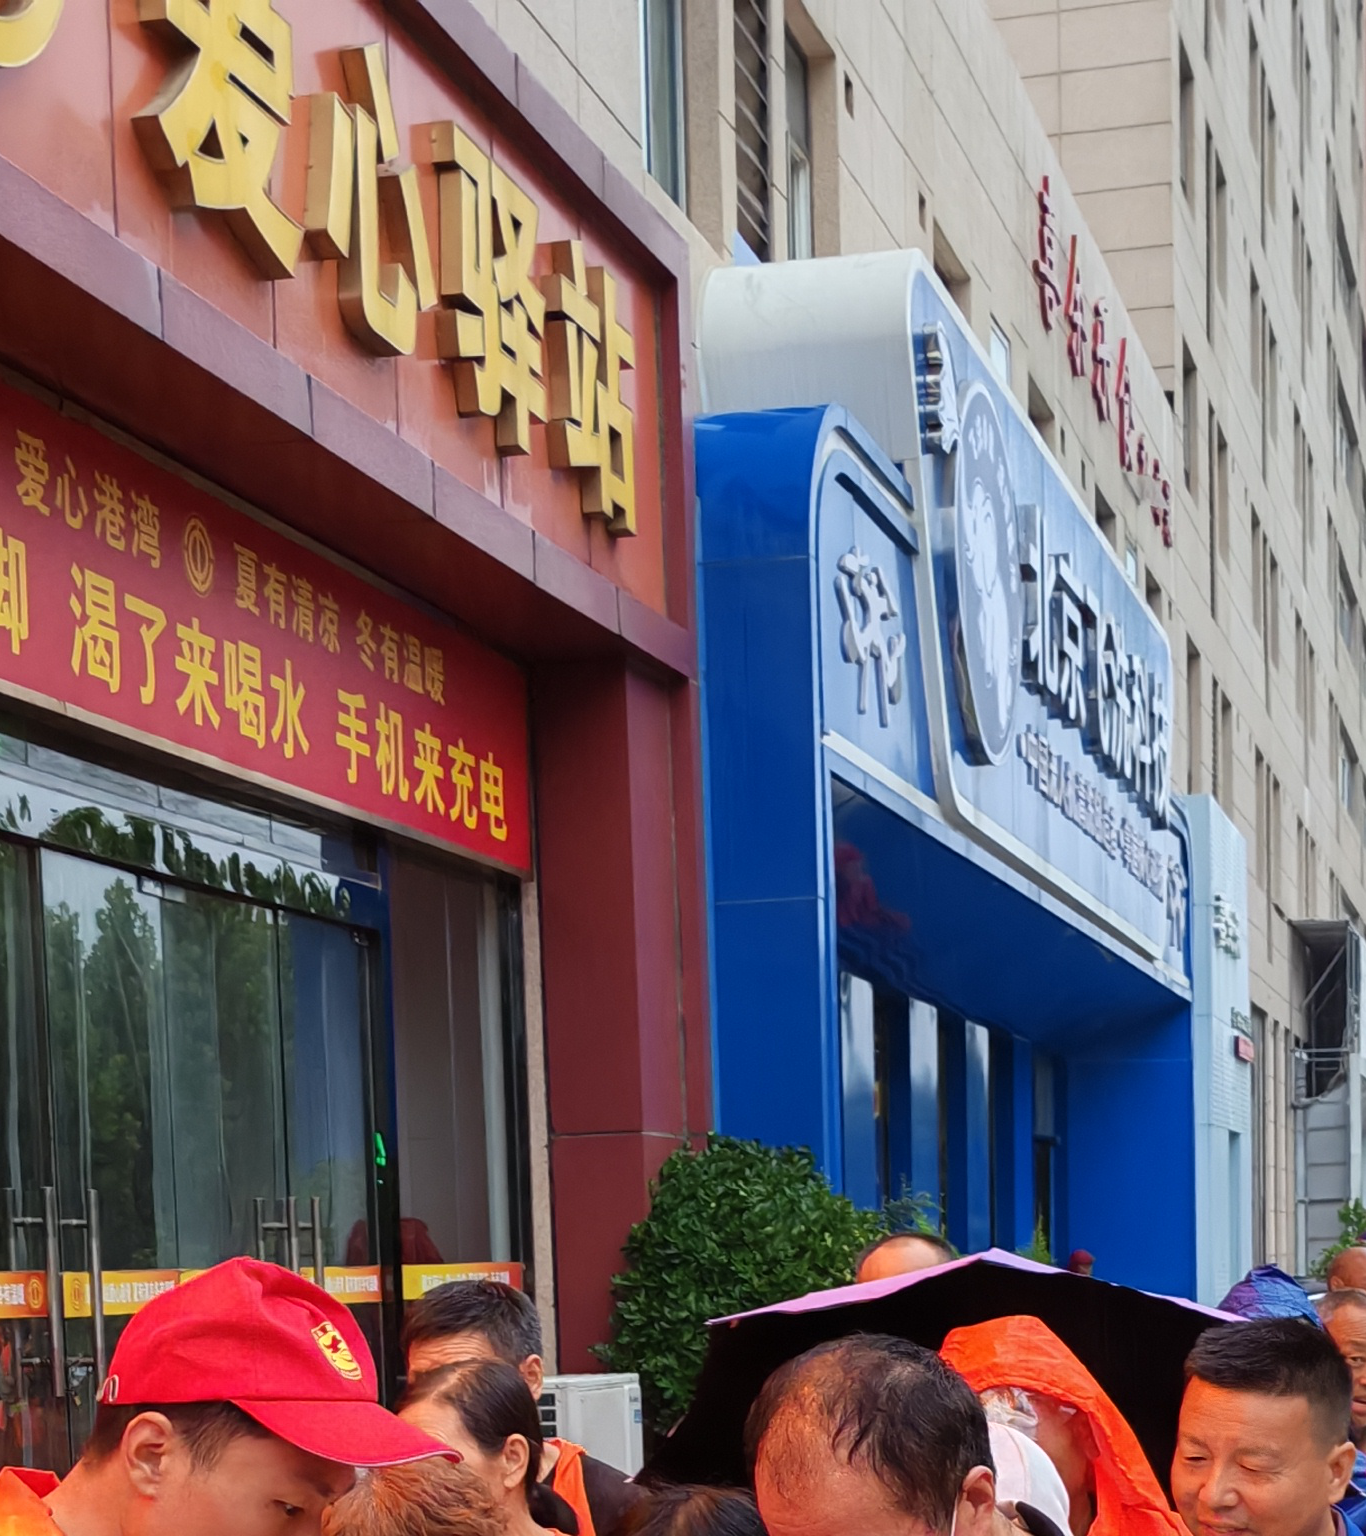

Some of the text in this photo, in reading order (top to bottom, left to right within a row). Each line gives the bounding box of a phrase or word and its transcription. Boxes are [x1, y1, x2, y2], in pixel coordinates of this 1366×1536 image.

[133, 0, 638, 539] 爱心驿站
[14, 430, 162, 568] 爱心港湾
[232, 541, 340, 655] 夏有清凉
[354, 610, 446, 704] 冬有温暖
[69, 561, 309, 760] 渴了来喝水
[336, 689, 508, 842] 手机来充电
